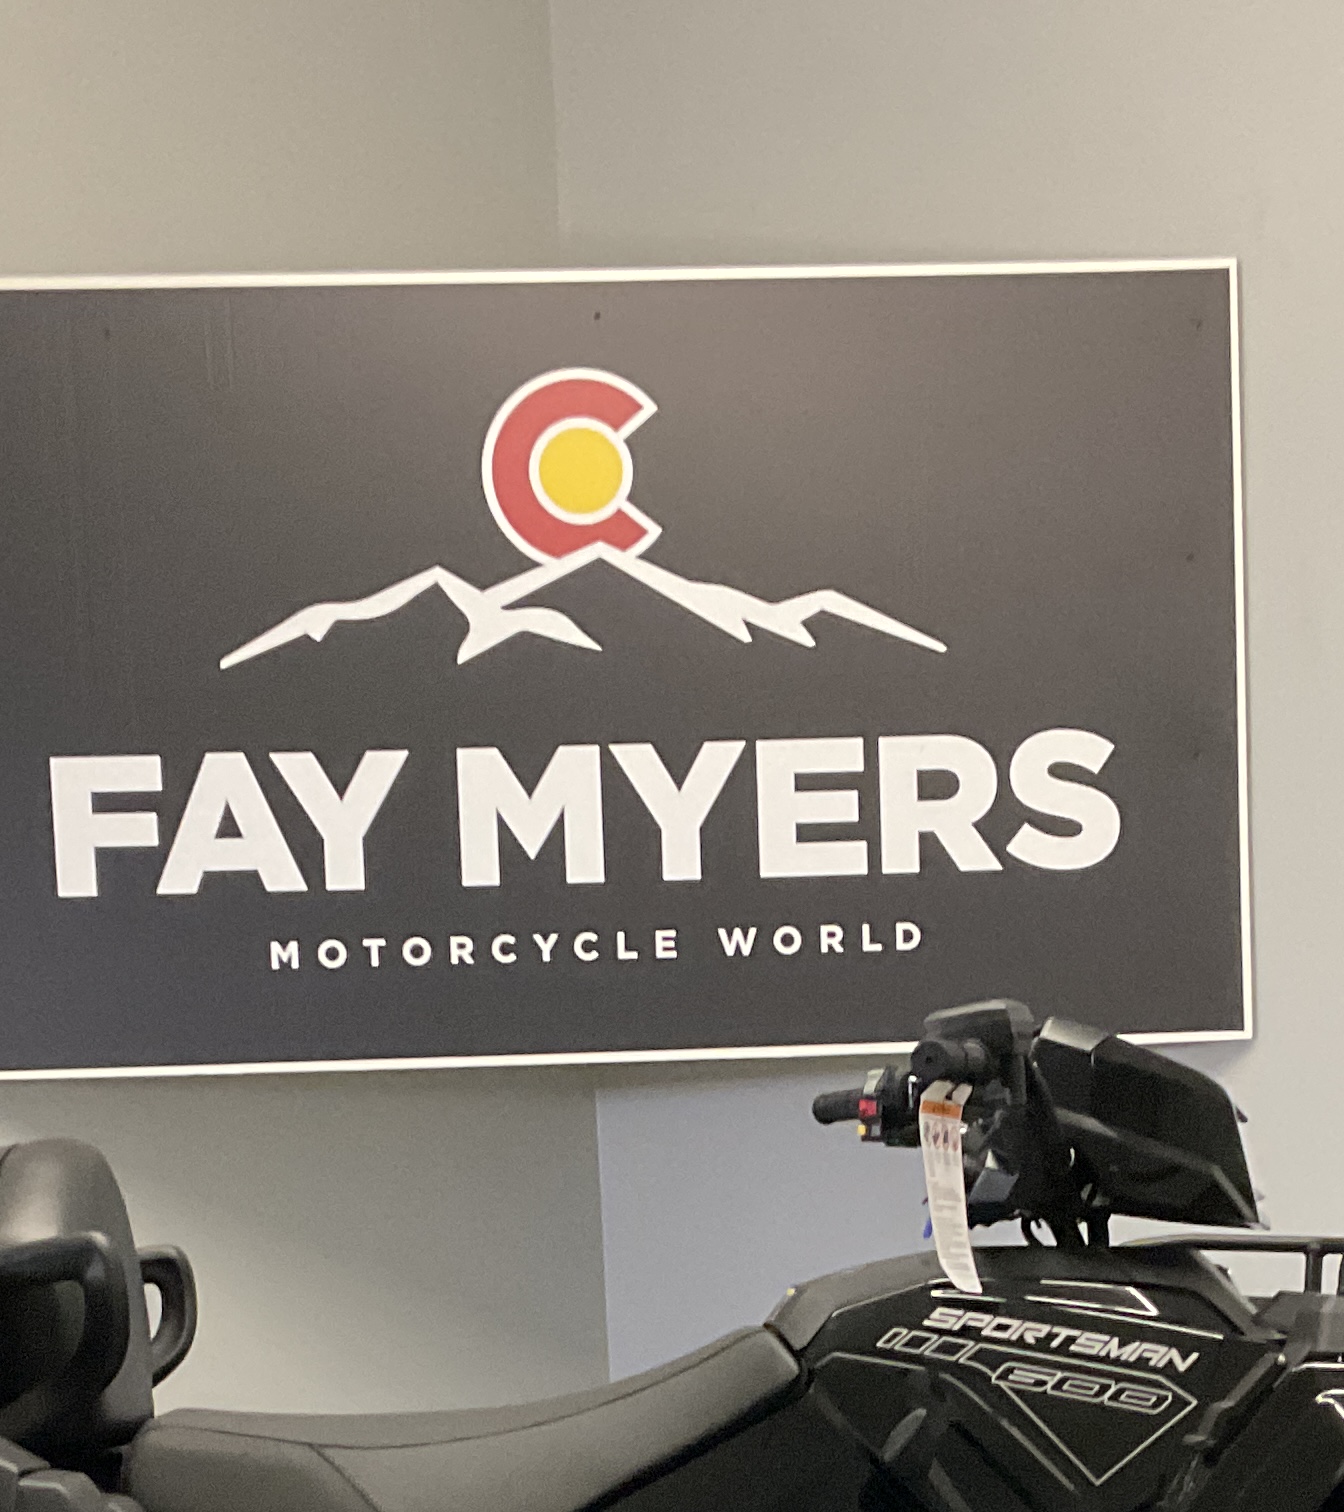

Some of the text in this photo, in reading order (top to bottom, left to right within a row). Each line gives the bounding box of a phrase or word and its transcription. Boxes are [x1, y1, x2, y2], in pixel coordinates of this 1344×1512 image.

[50, 729, 1120, 897] FAY MYERS
[270, 922, 921, 970] MOTORCYCLE WORLD
[922, 1306, 1199, 1372] SPORTSMAN
